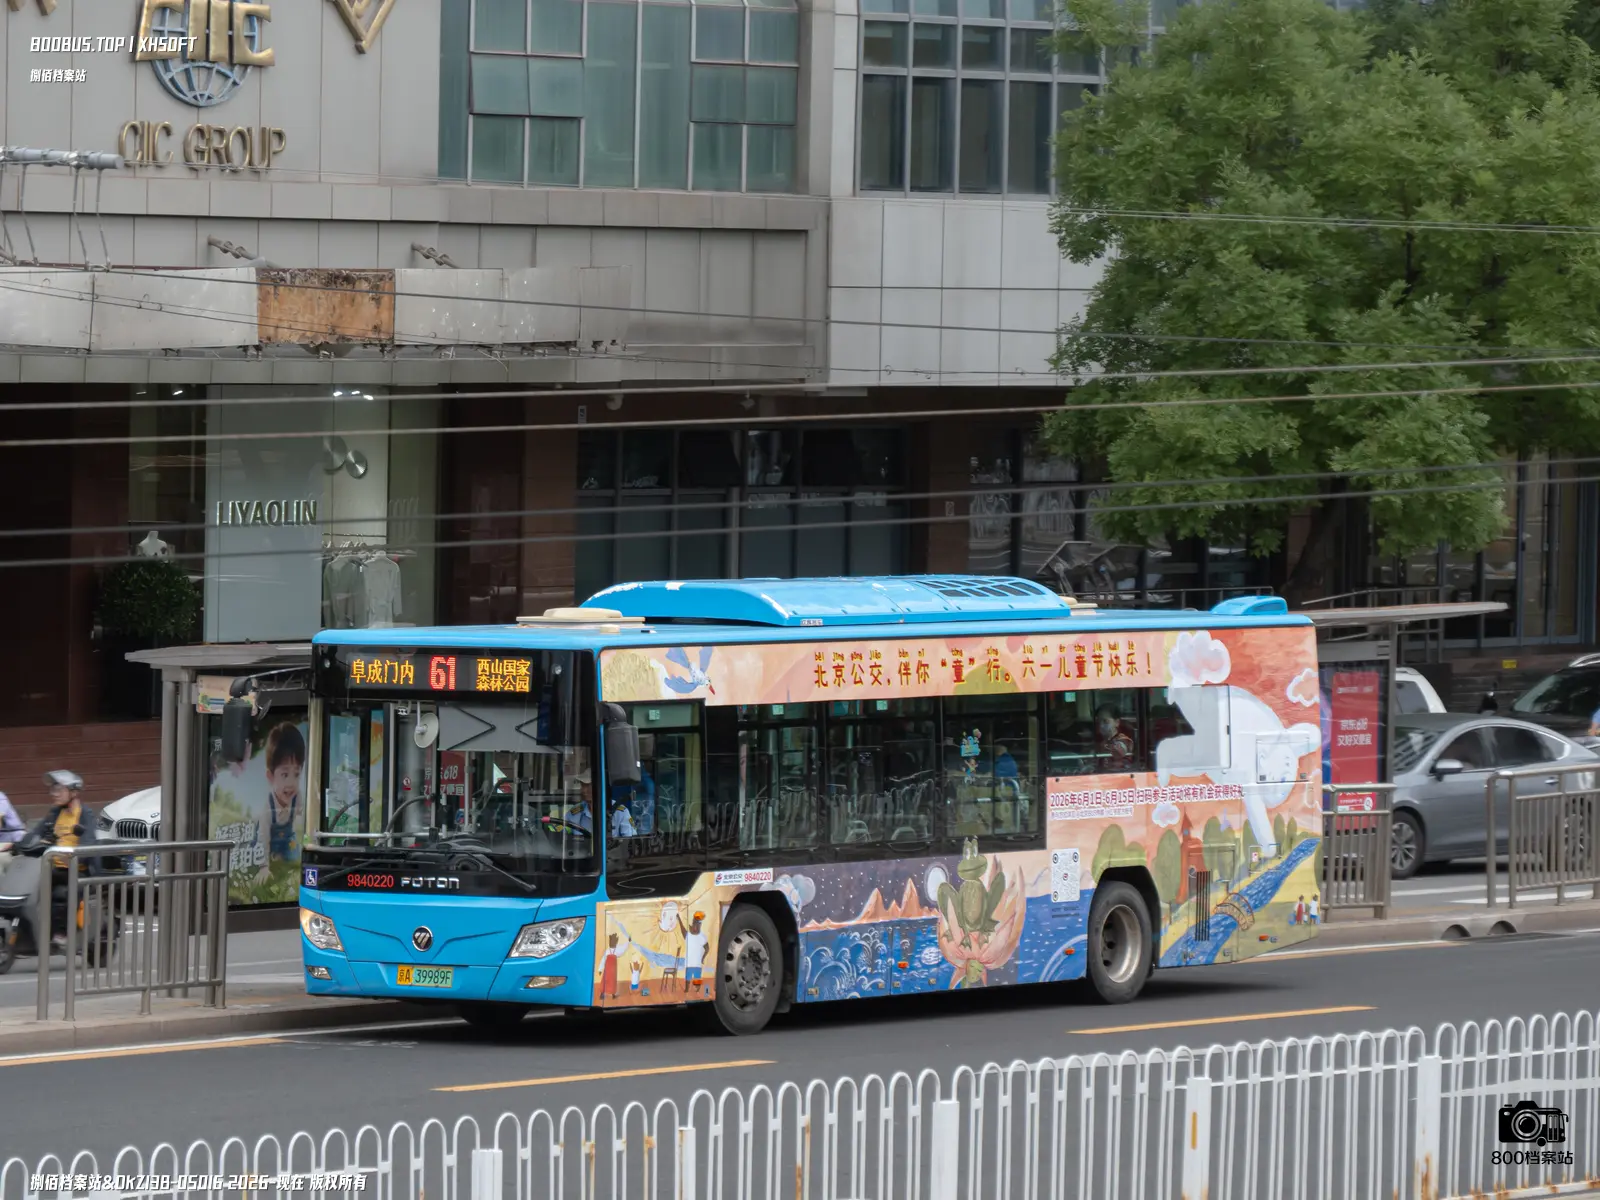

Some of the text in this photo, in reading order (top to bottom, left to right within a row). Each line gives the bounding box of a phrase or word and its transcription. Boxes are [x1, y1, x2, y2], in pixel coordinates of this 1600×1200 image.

[183, 123, 286, 173] GROUP
[216, 500, 318, 526] LIYAOLIN
[351, 659, 414, 684] 阜成门内
[430, 656, 456, 690] 61
[477, 659, 531, 675] 西山国家
[476, 675, 530, 692] 森林公园
[347, 874, 460, 889] 9840220 FOTON
[744, 871, 772, 882] 9840220
[415, 968, 452, 985] 39989F
